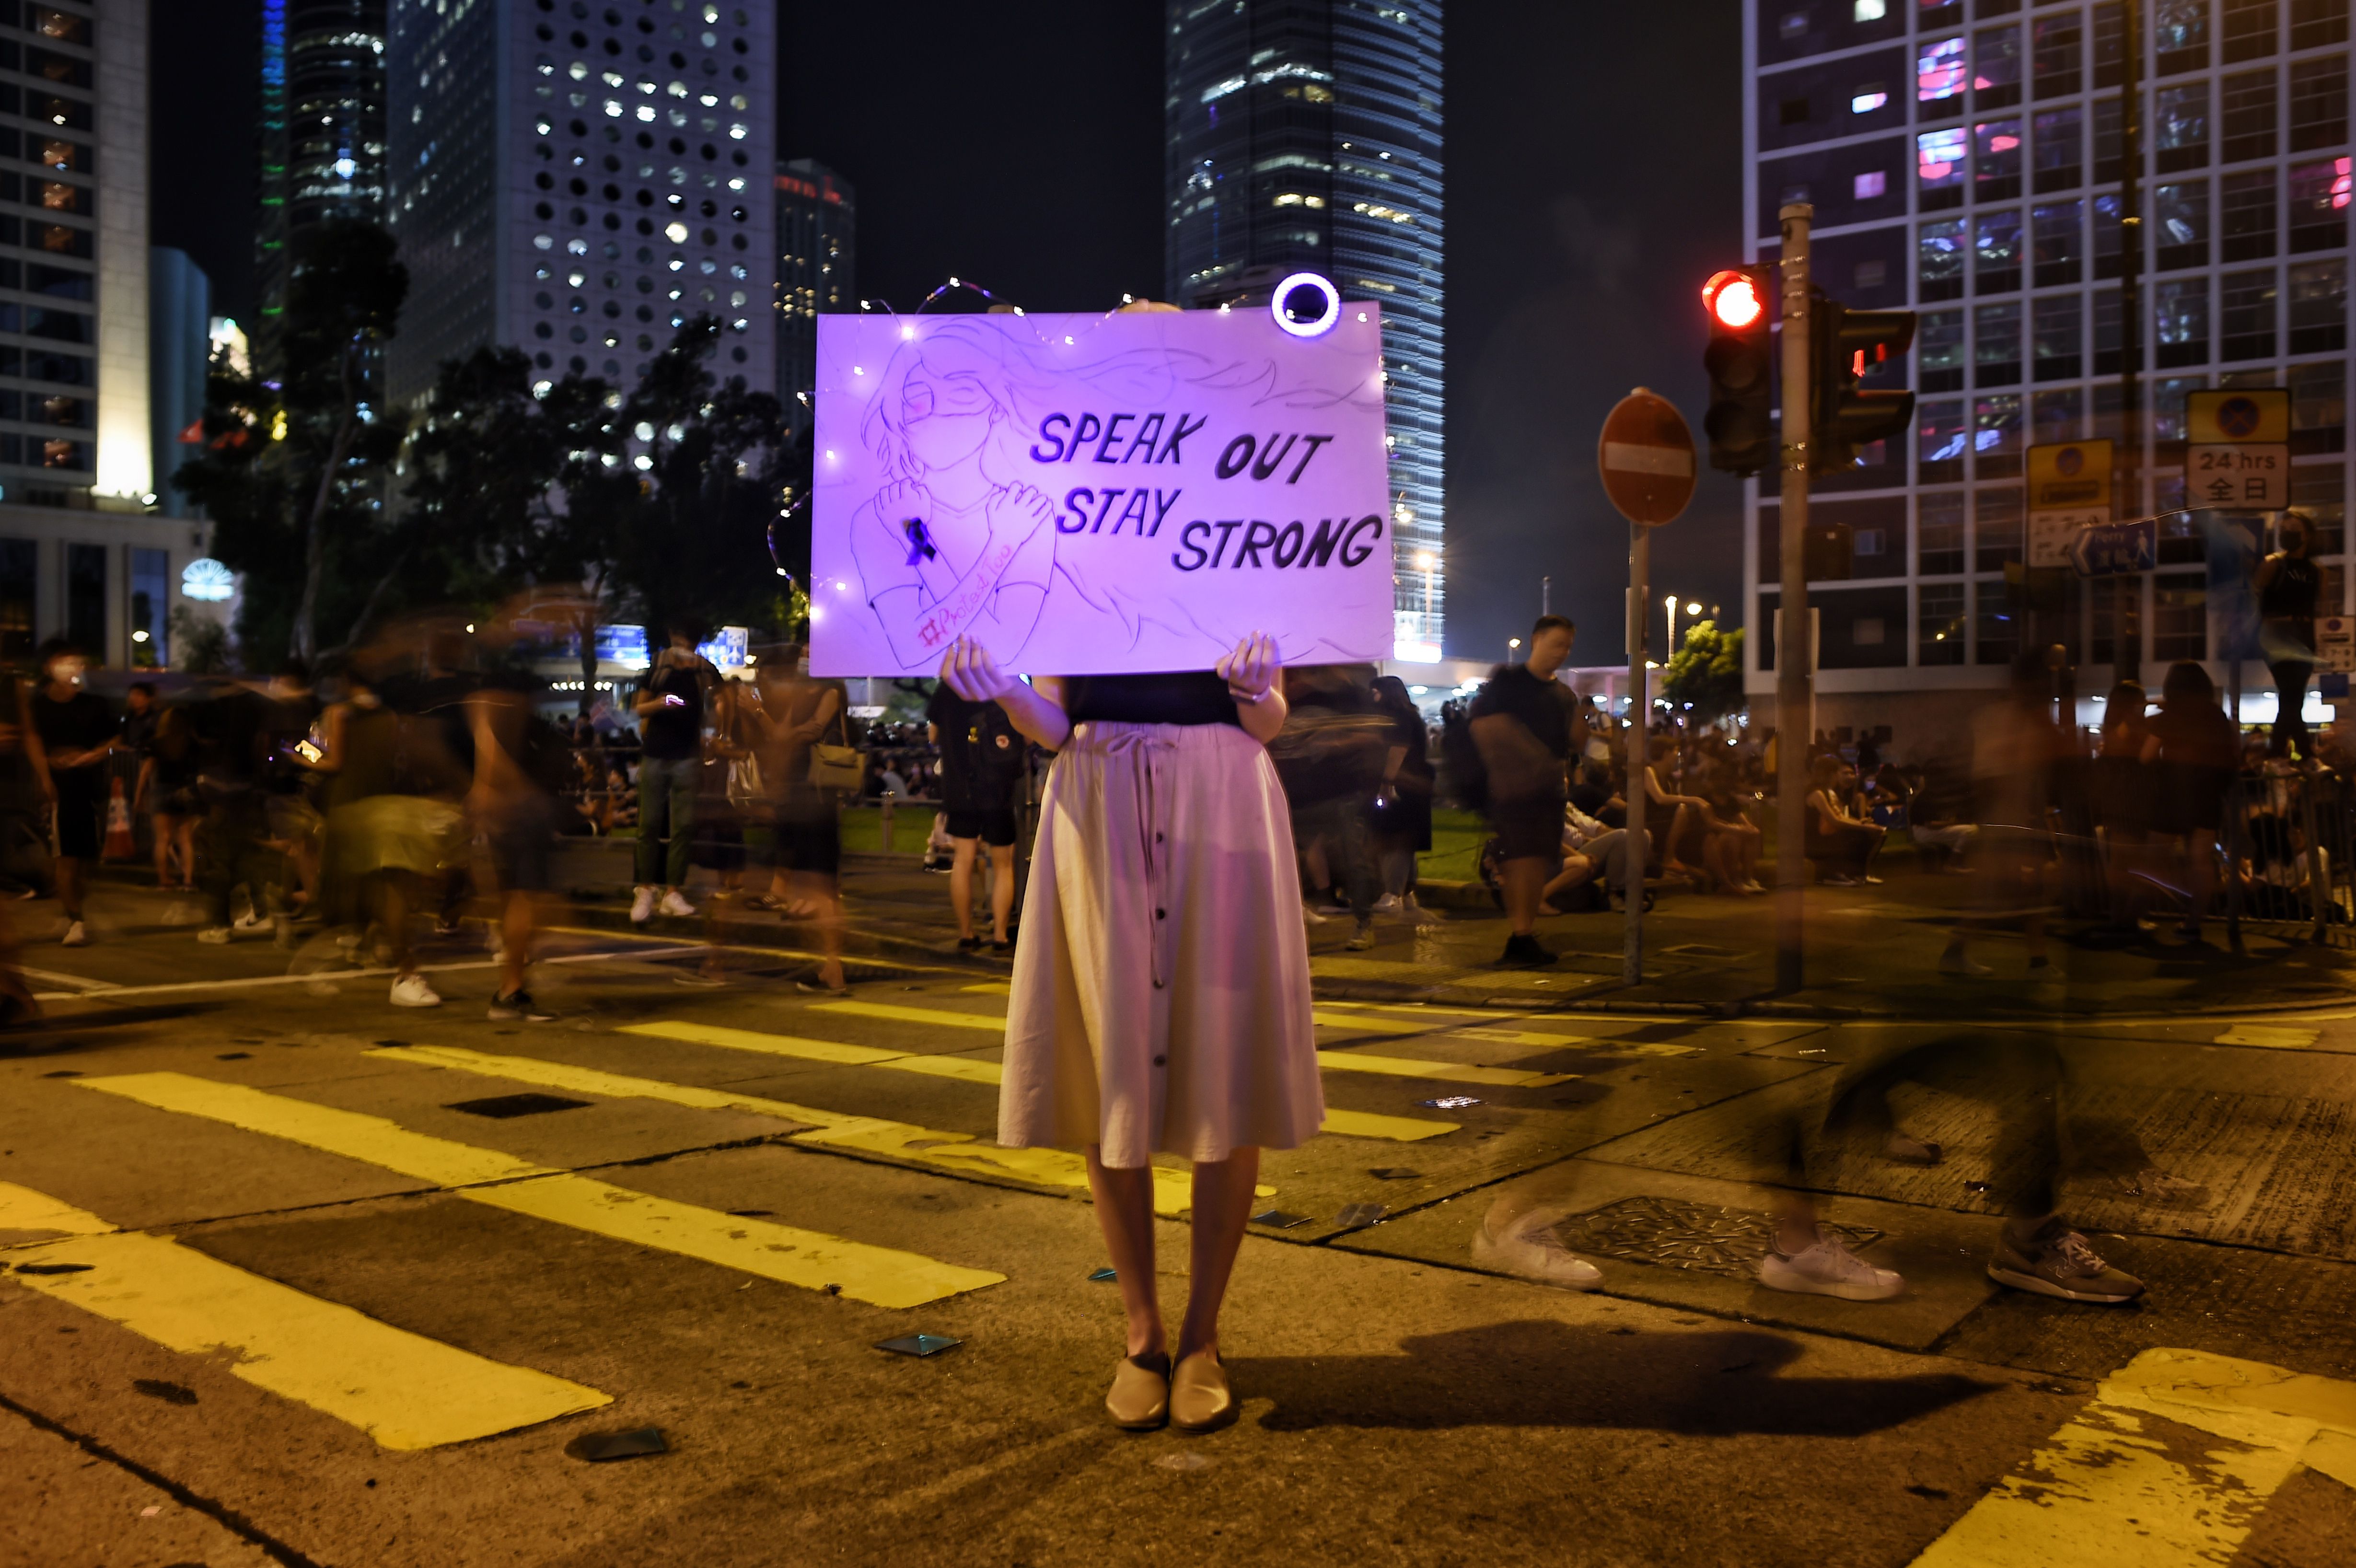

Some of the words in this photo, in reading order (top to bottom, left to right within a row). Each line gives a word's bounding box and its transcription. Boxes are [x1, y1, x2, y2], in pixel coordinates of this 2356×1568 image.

[1030, 413, 1208, 464] SPEAK
[1215, 433, 1334, 484] OUT
[2199, 452, 2231, 470] 24
[2240, 453, 2275, 469] hrs
[2206, 477, 2267, 500] 全日
[1057, 487, 1182, 538] STAY
[1172, 515, 1383, 571] STRONG
